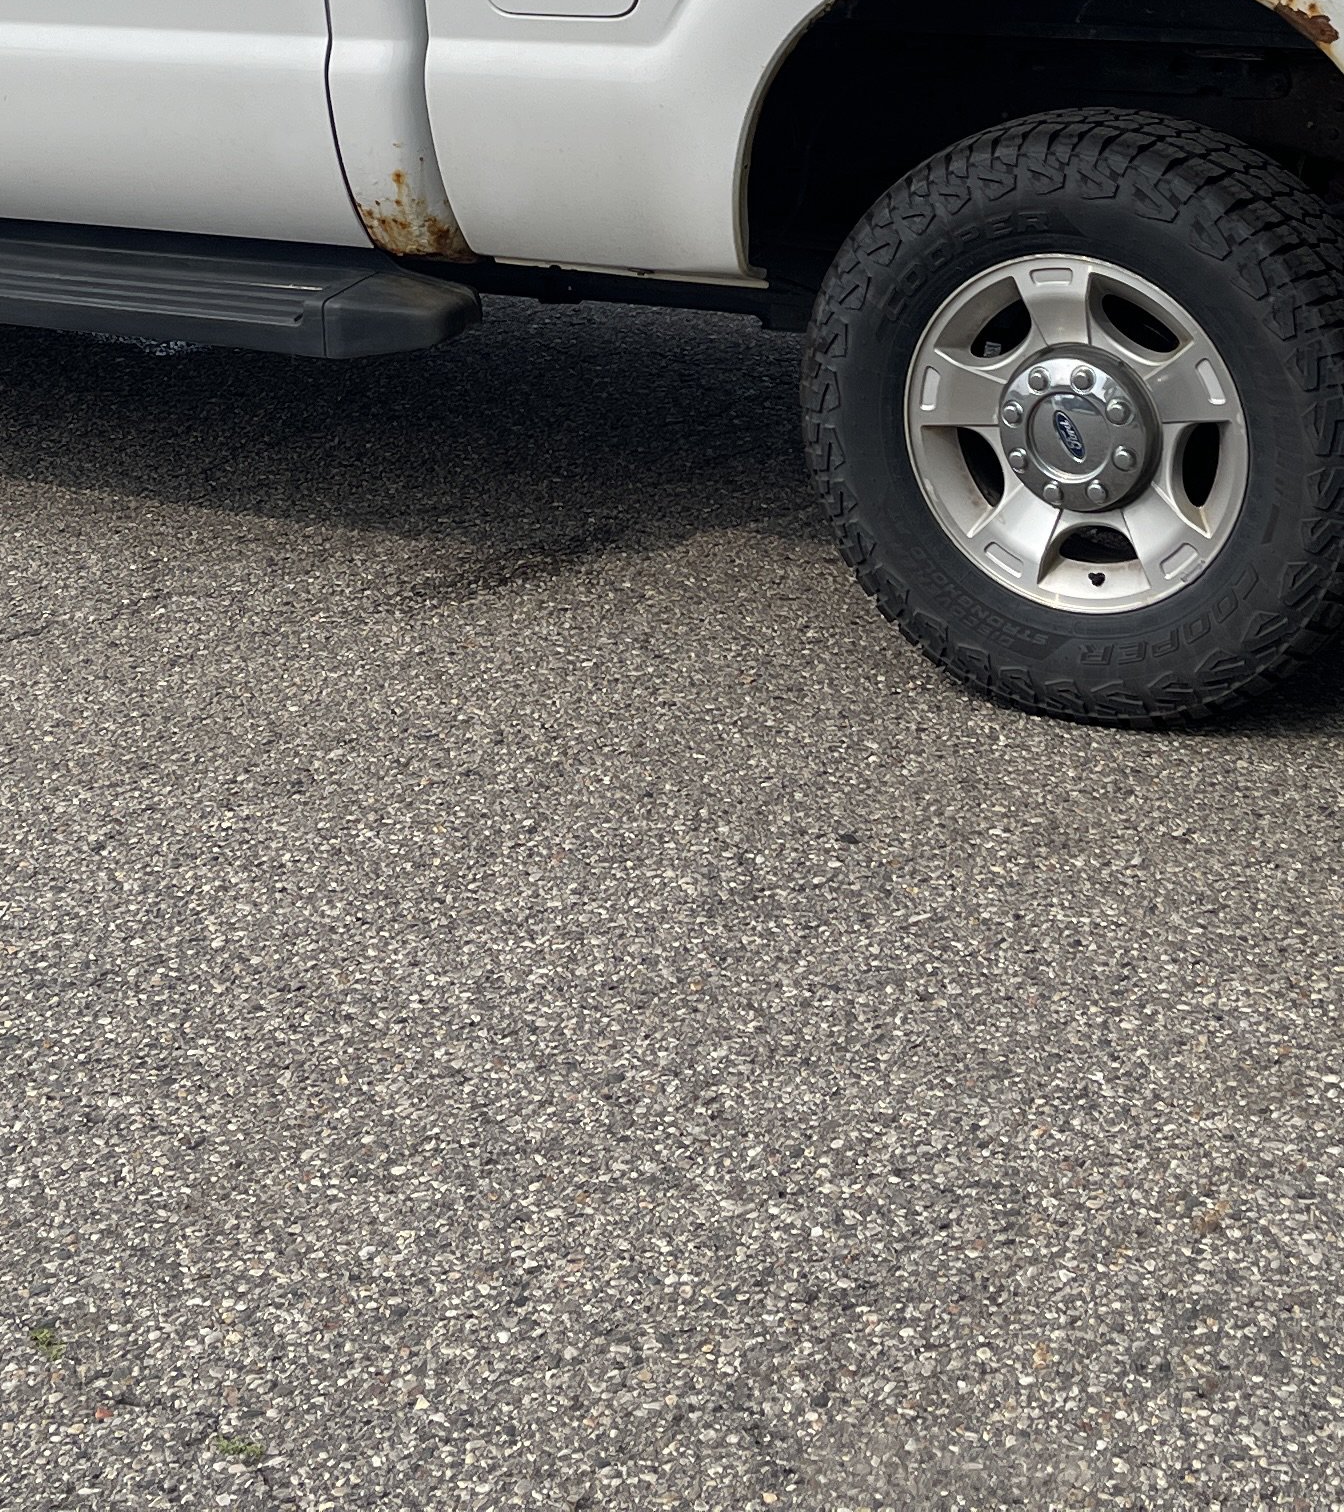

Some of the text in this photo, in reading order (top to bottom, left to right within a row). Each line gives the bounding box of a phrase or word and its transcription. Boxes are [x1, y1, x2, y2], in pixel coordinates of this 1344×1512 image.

[880, 210, 1051, 322] COOPER
[1059, 419, 1083, 450] Ford
[1078, 562, 1260, 667] COOPER
